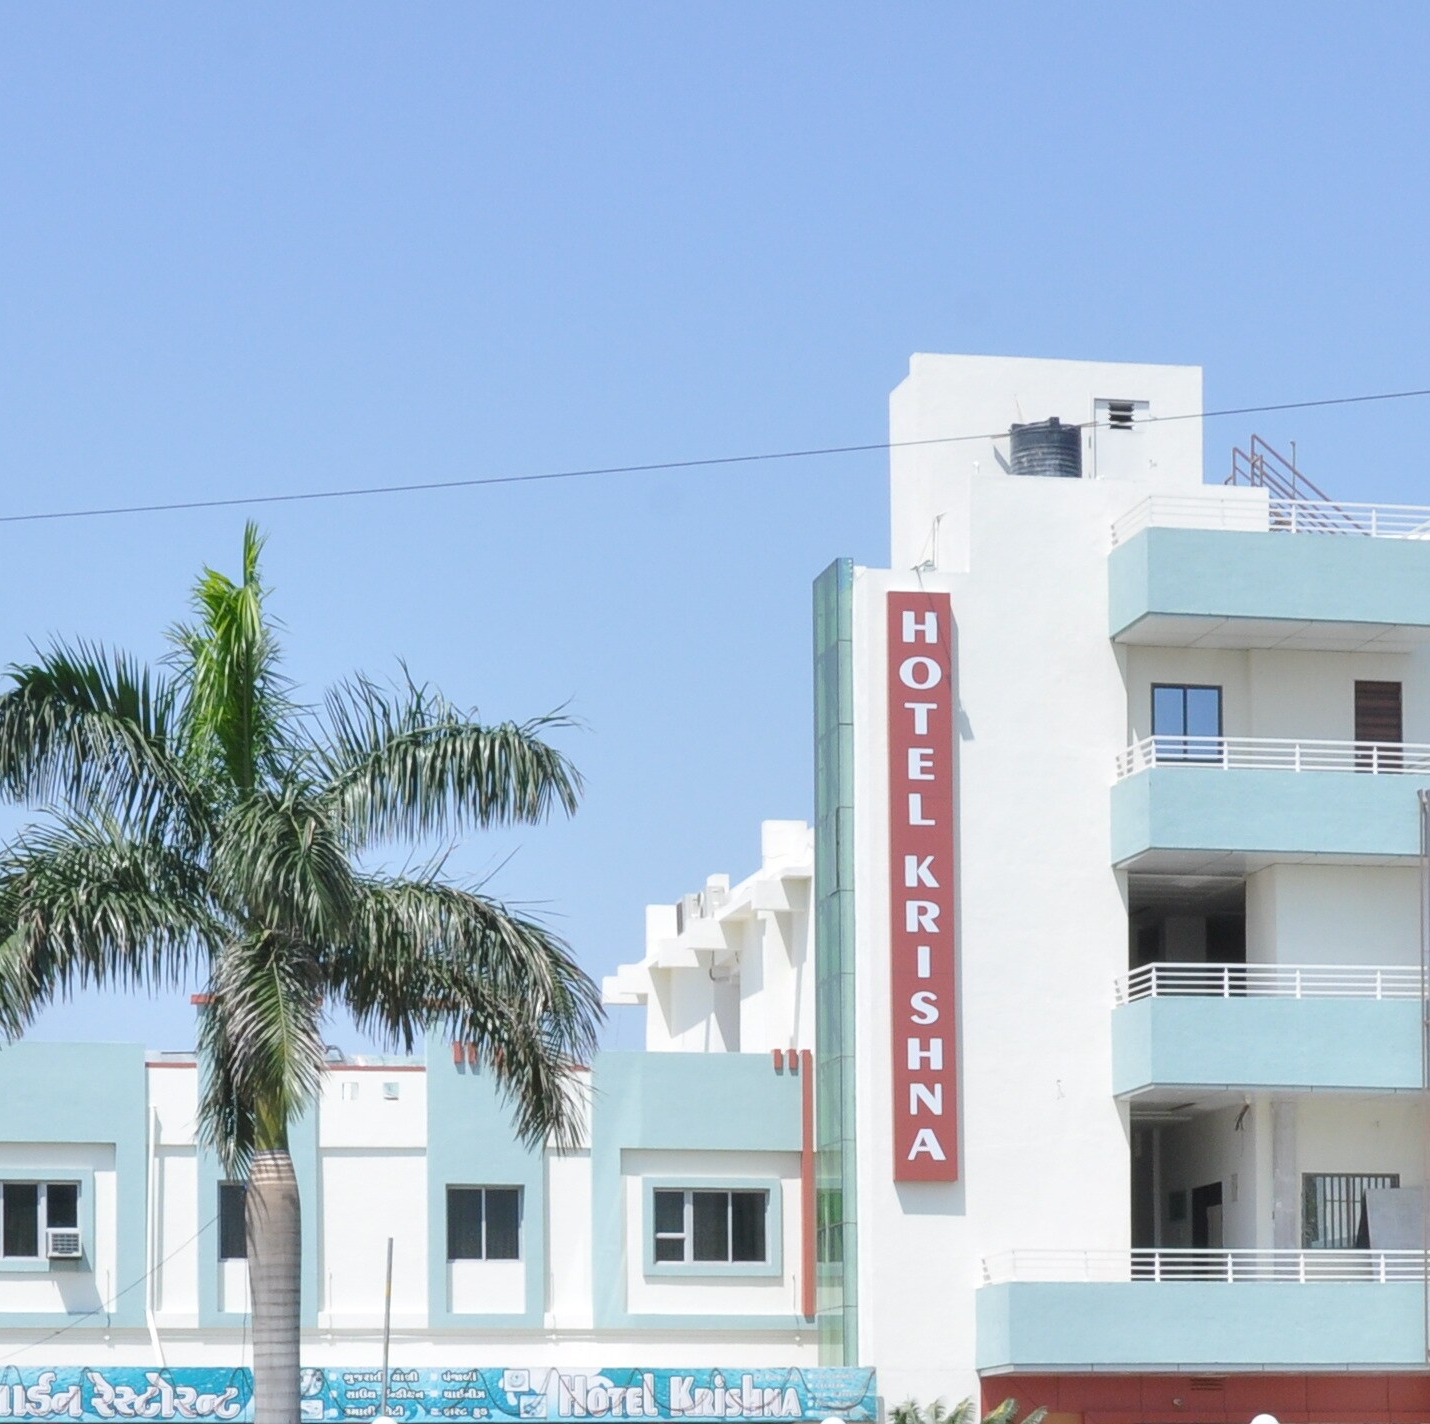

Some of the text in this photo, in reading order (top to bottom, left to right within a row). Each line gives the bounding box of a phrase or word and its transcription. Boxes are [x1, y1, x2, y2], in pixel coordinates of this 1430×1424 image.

[898, 610, 946, 1161] HOTEL KRISHNA
[86, 1371, 241, 1419] રેસ્ટોરન્ટ
